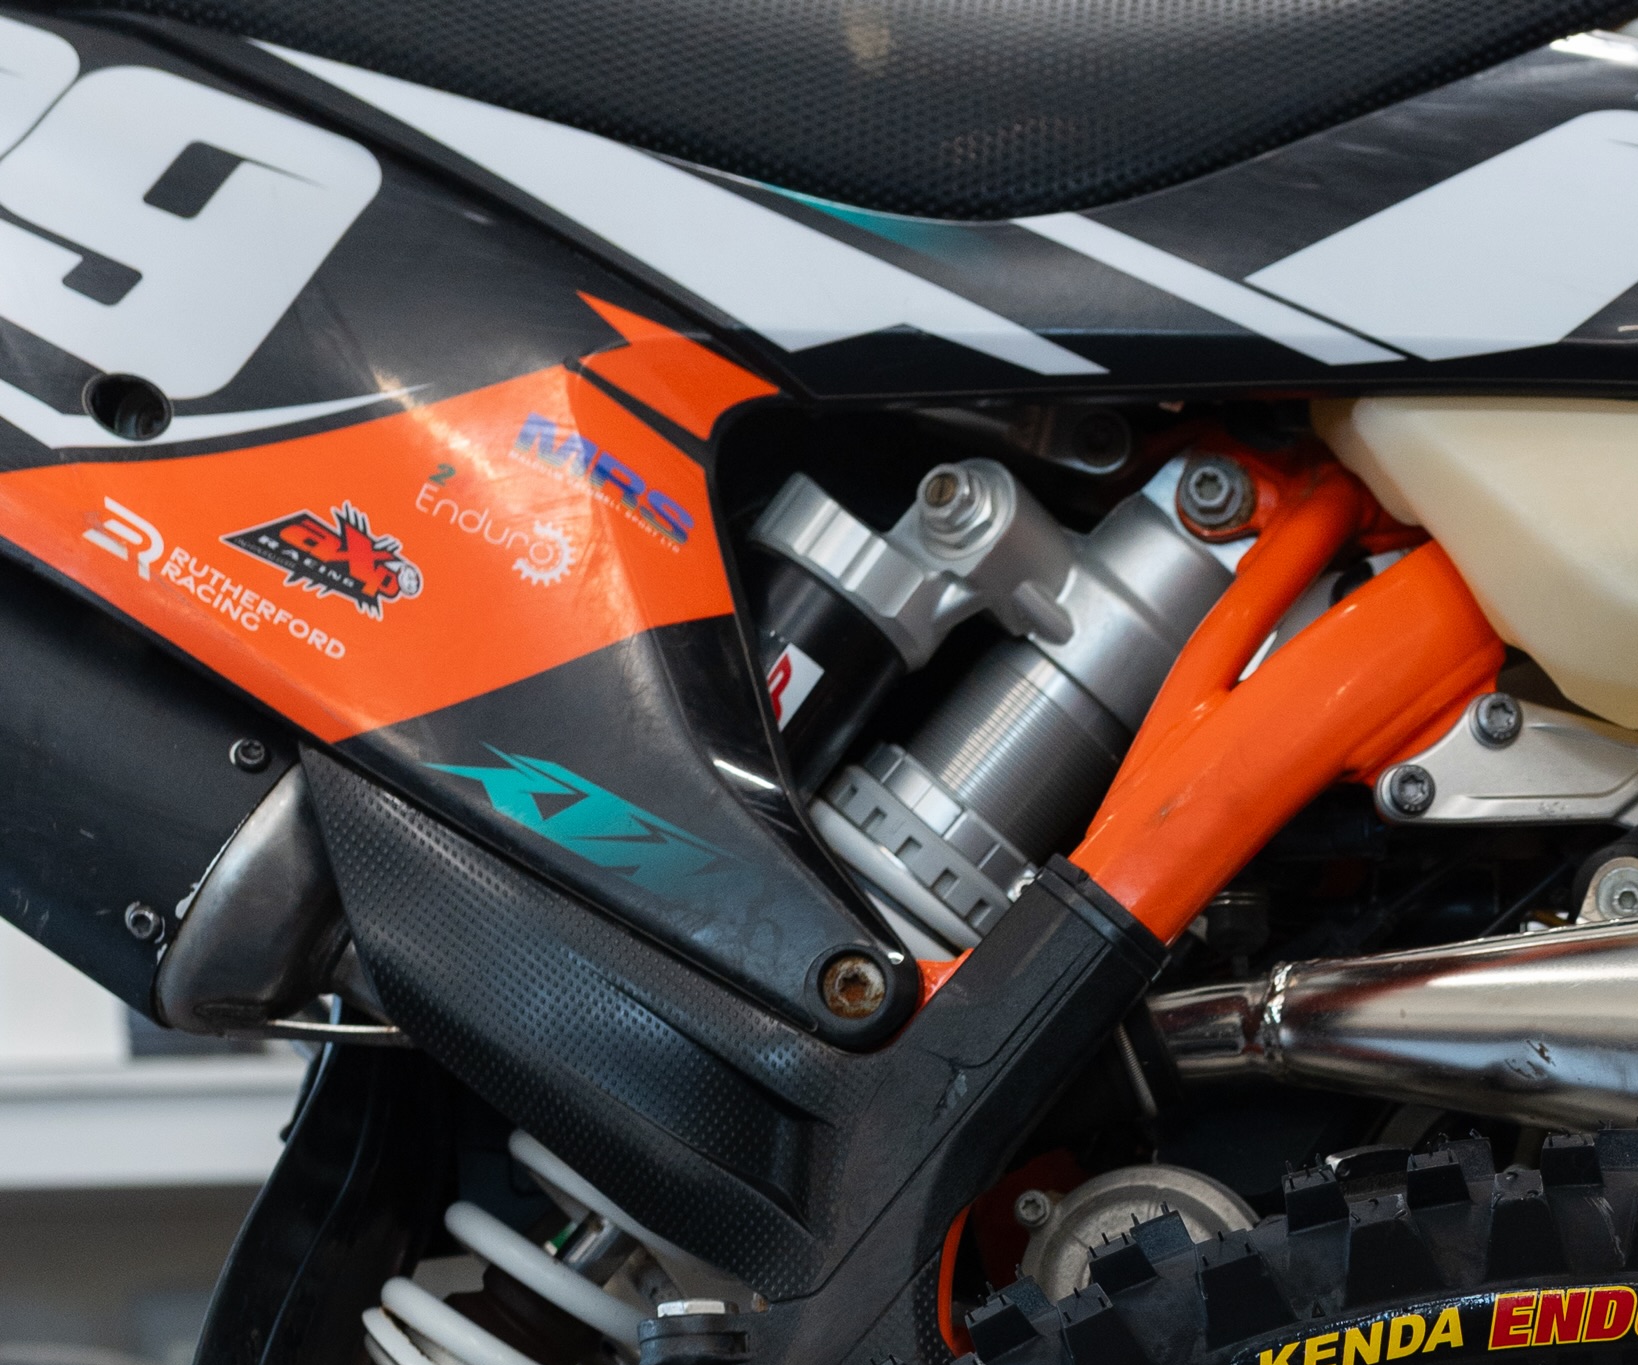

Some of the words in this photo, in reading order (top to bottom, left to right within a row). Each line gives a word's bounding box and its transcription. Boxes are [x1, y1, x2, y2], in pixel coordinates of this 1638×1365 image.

[513, 411, 694, 545] MRS
[159, 558, 264, 633] RACING
[168, 545, 348, 662] RUTHERFORD
